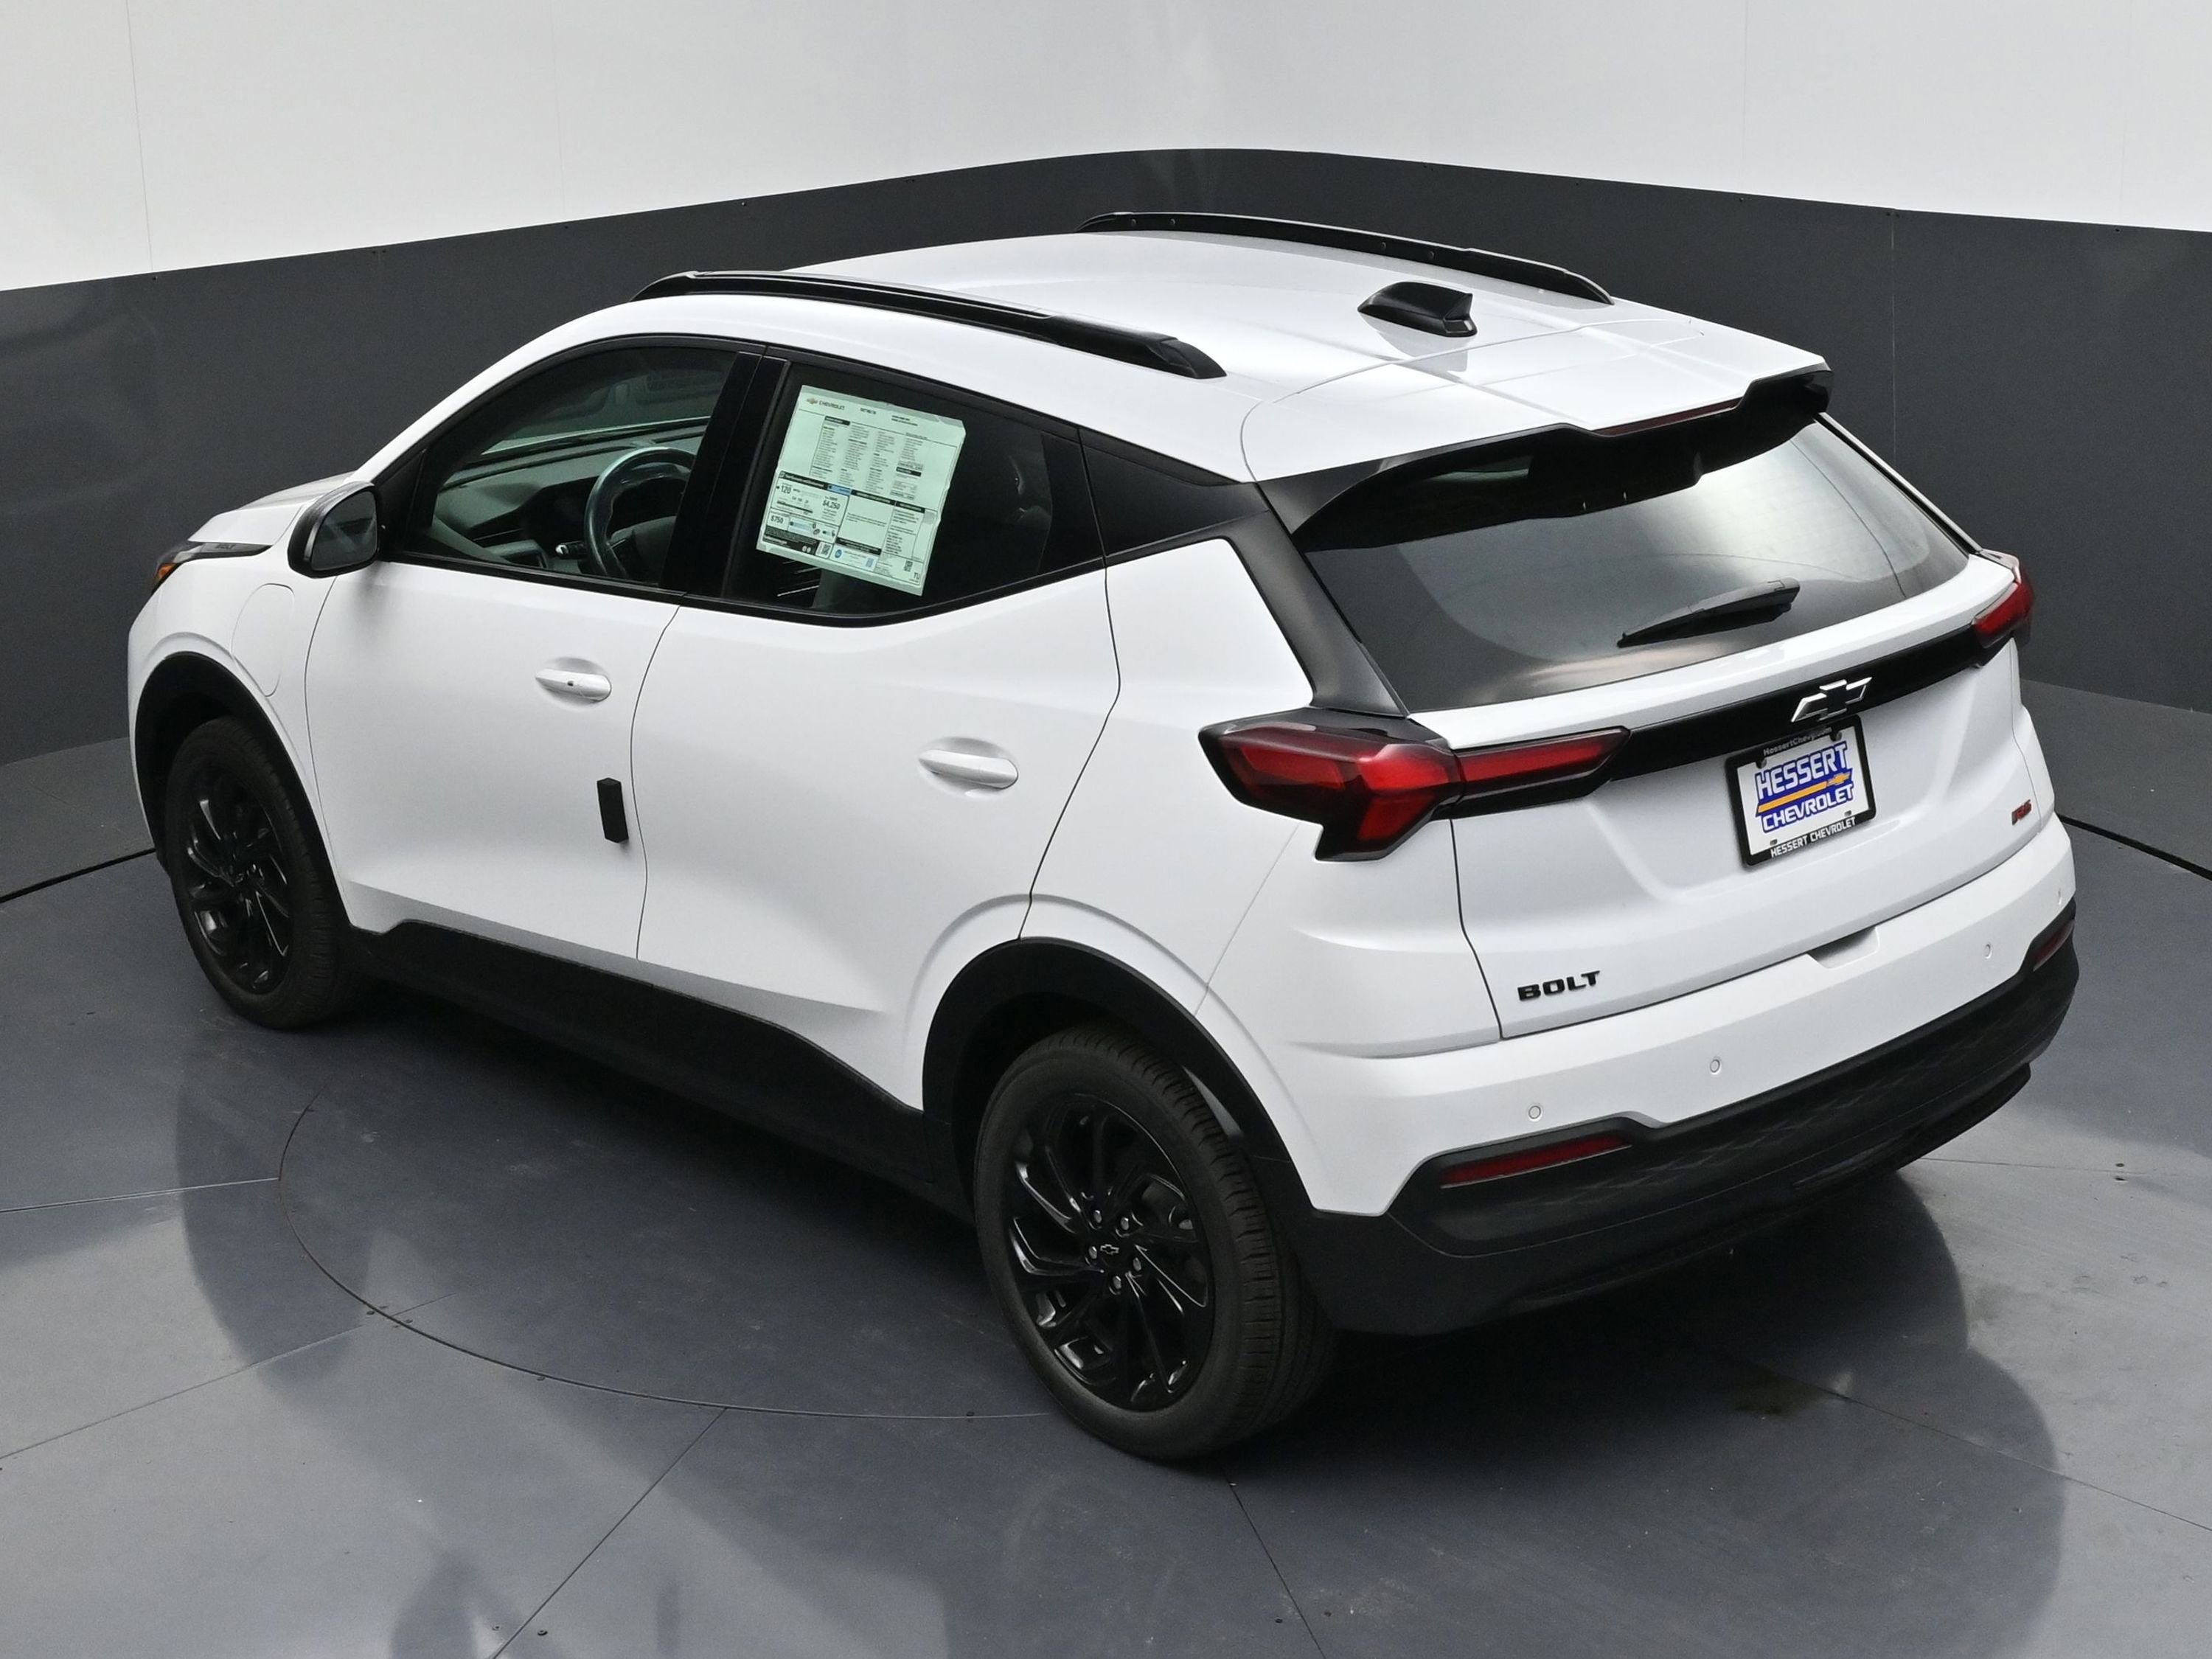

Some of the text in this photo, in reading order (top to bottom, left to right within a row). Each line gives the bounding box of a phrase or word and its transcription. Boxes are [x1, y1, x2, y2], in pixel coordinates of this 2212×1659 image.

[1756, 742, 1848, 799] HESSERT
[1761, 783, 1854, 832] CHEVROLET
[1770, 817, 1856, 858] HESSERT CHEVROLET
[1517, 970, 1600, 1001] BOLT
